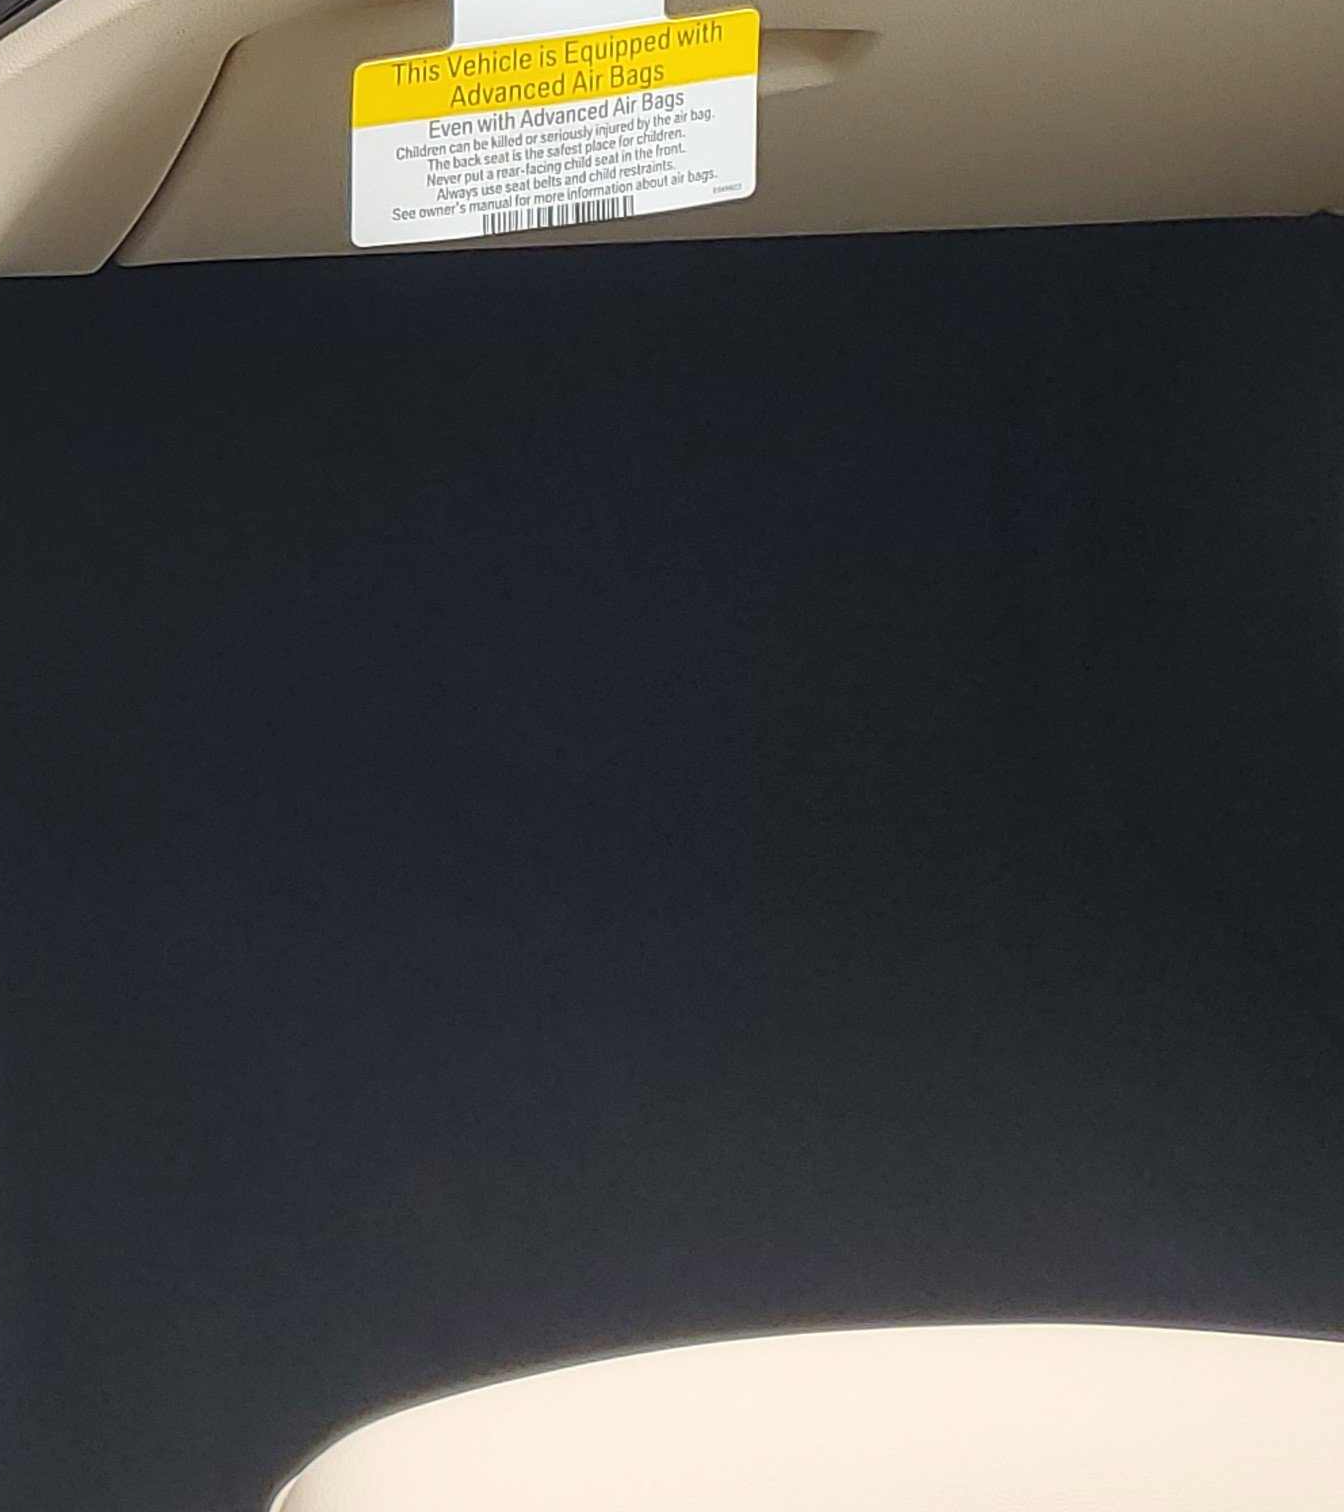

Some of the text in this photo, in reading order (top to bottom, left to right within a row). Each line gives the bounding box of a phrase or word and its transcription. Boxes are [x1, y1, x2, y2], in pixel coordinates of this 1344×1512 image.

[391, 20, 723, 87] This Vehicle is Equipped with
[450, 62, 665, 108] Advanced Air Bags
[396, 107, 715, 160] Children can be killed or seriously injured by the air bag.
[429, 90, 685, 139] Even with Advanced Air Bags
[427, 142, 686, 187] Never put a rear-facing child seat in the front.
[428, 130, 686, 171] The back seat is the safest place for children.
[392, 169, 718, 222] See owner's manual for more information about air bags.
[437, 160, 676, 201] Always use seat belts and child restraints.
